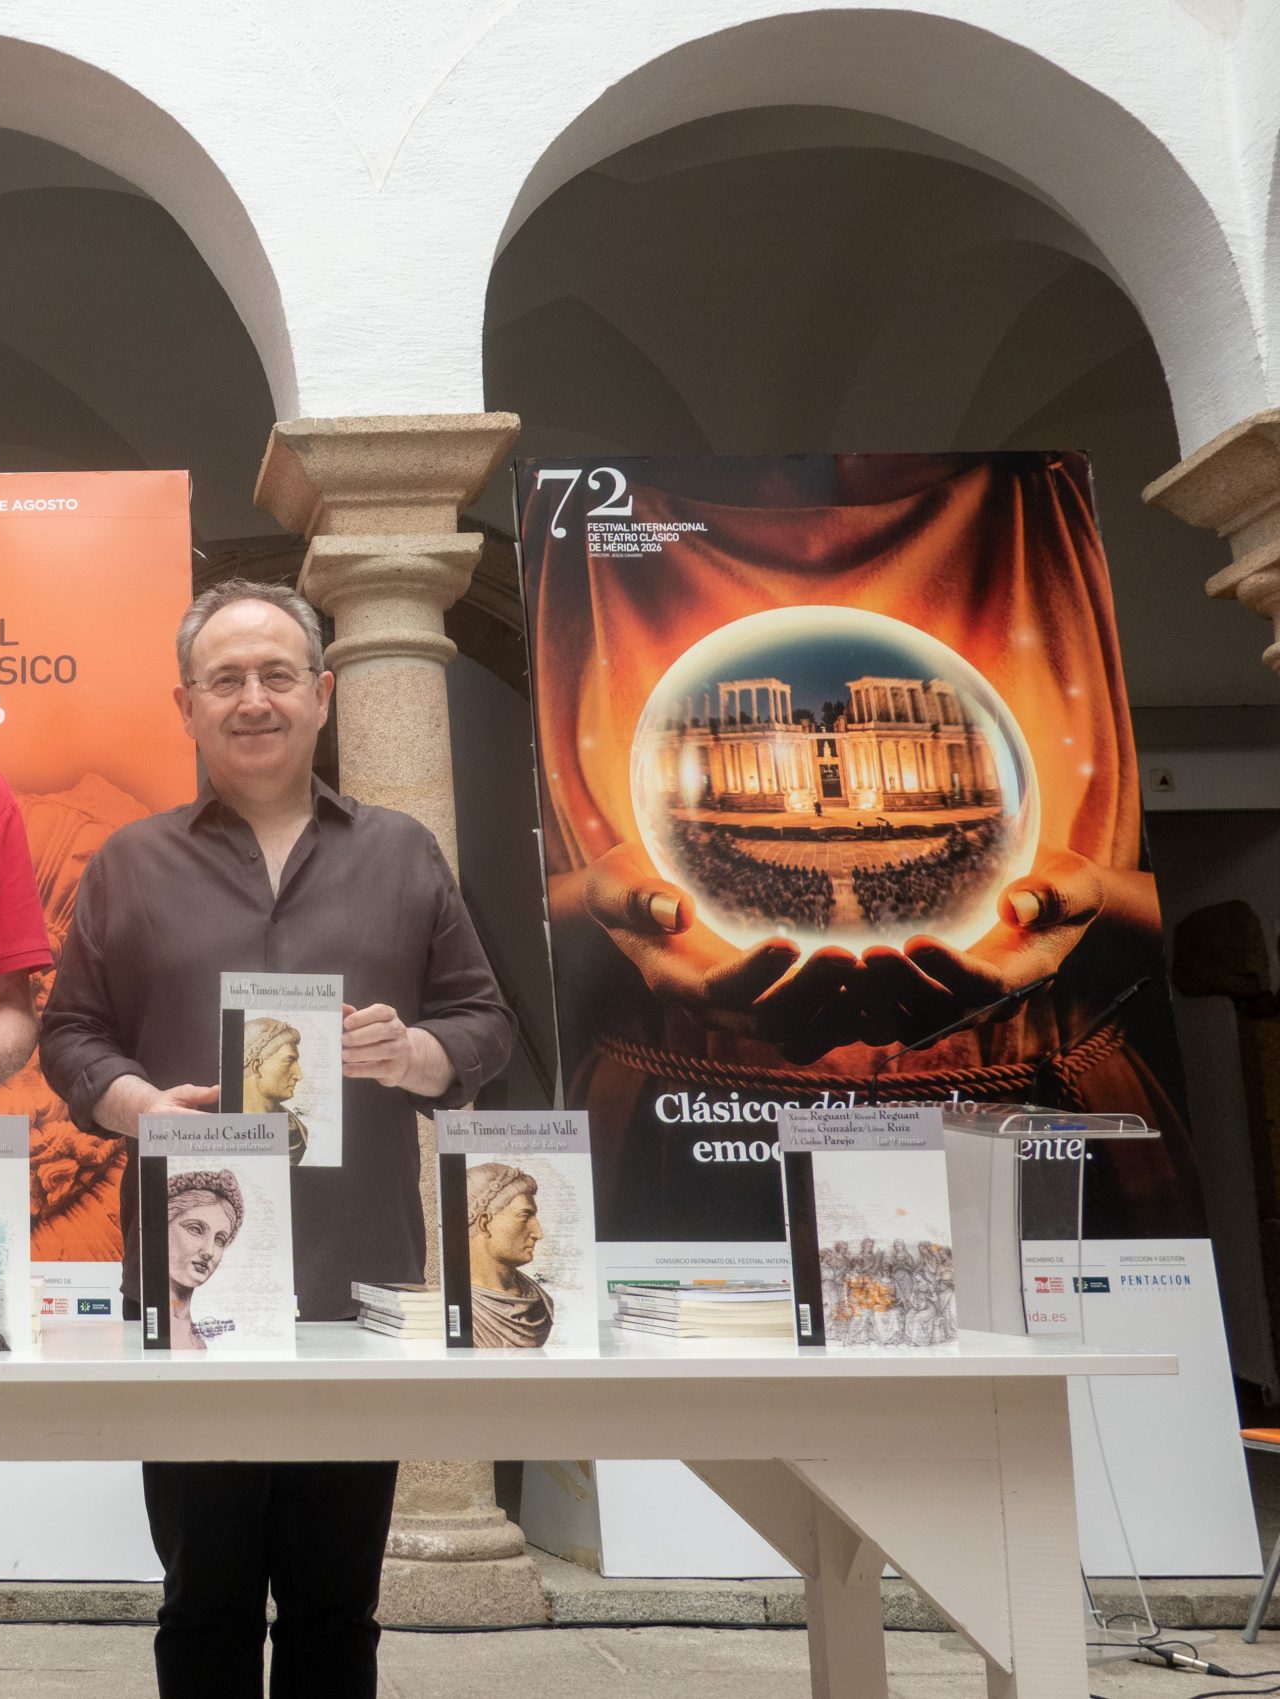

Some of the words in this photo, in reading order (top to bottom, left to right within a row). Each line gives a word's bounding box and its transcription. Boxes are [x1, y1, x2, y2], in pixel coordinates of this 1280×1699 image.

[12, 498, 78, 512] AGOSTO
[536, 466, 633, 538] 72
[587, 522, 630, 532] FESTIVAL
[631, 522, 708, 532] INTERNACIONAL
[588, 533, 600, 542] DE
[602, 533, 638, 542] TEATRO
[639, 530, 680, 542] CLÁSICO
[588, 543, 602, 552] DE
[603, 541, 640, 552] MÉRIDA
[640, 542, 662, 552] 2026
[304, 986, 314, 996] del
[316, 984, 336, 997] Valle
[654, 1092, 801, 1124] Clásicos
[879, 1110, 920, 1122] Reguant
[148, 1130, 168, 1142] José
[172, 1129, 201, 1140] María
[204, 1128, 218, 1140] del
[222, 1124, 274, 1140] Castillo
[446, 1124, 469, 1135] Isidro
[538, 1124, 551, 1135] del
[552, 1120, 578, 1135] Valle
[824, 1136, 855, 1146] Parejo
[1120, 1274, 1192, 1286] PENTACION
